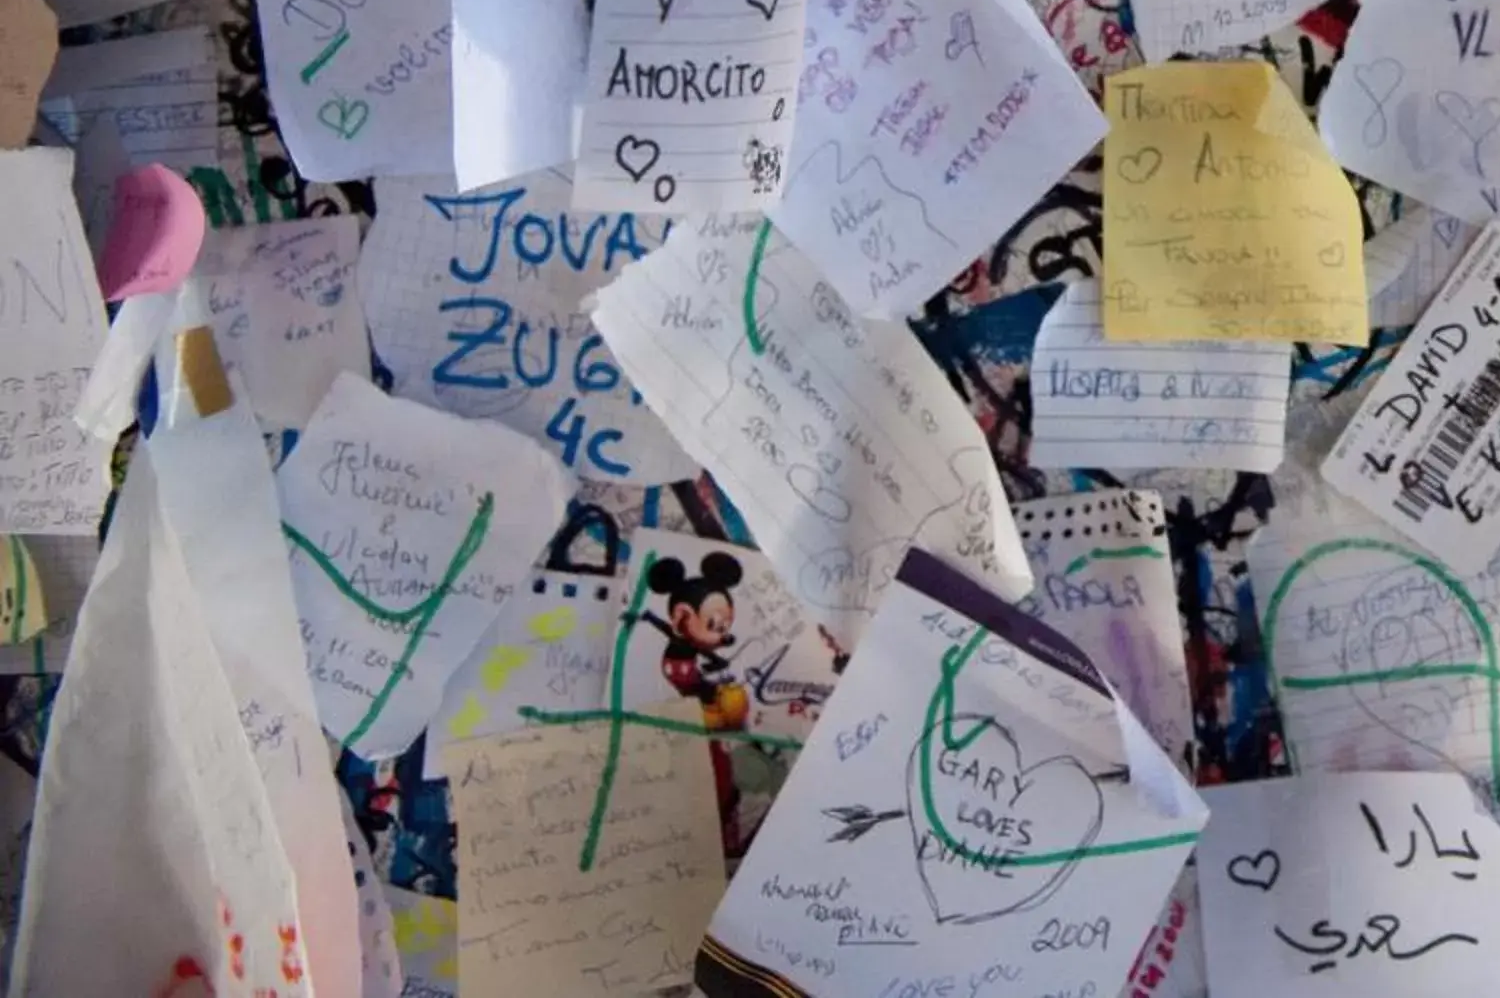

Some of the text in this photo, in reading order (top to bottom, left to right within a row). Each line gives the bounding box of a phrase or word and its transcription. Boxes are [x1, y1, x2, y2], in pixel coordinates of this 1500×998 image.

[545, 396, 632, 477] 4C
[937, 748, 1033, 808] GARY
[956, 802, 1033, 848] LOVES
[1358, 802, 1482, 880] يارا
[1032, 917, 1112, 952] 2009
